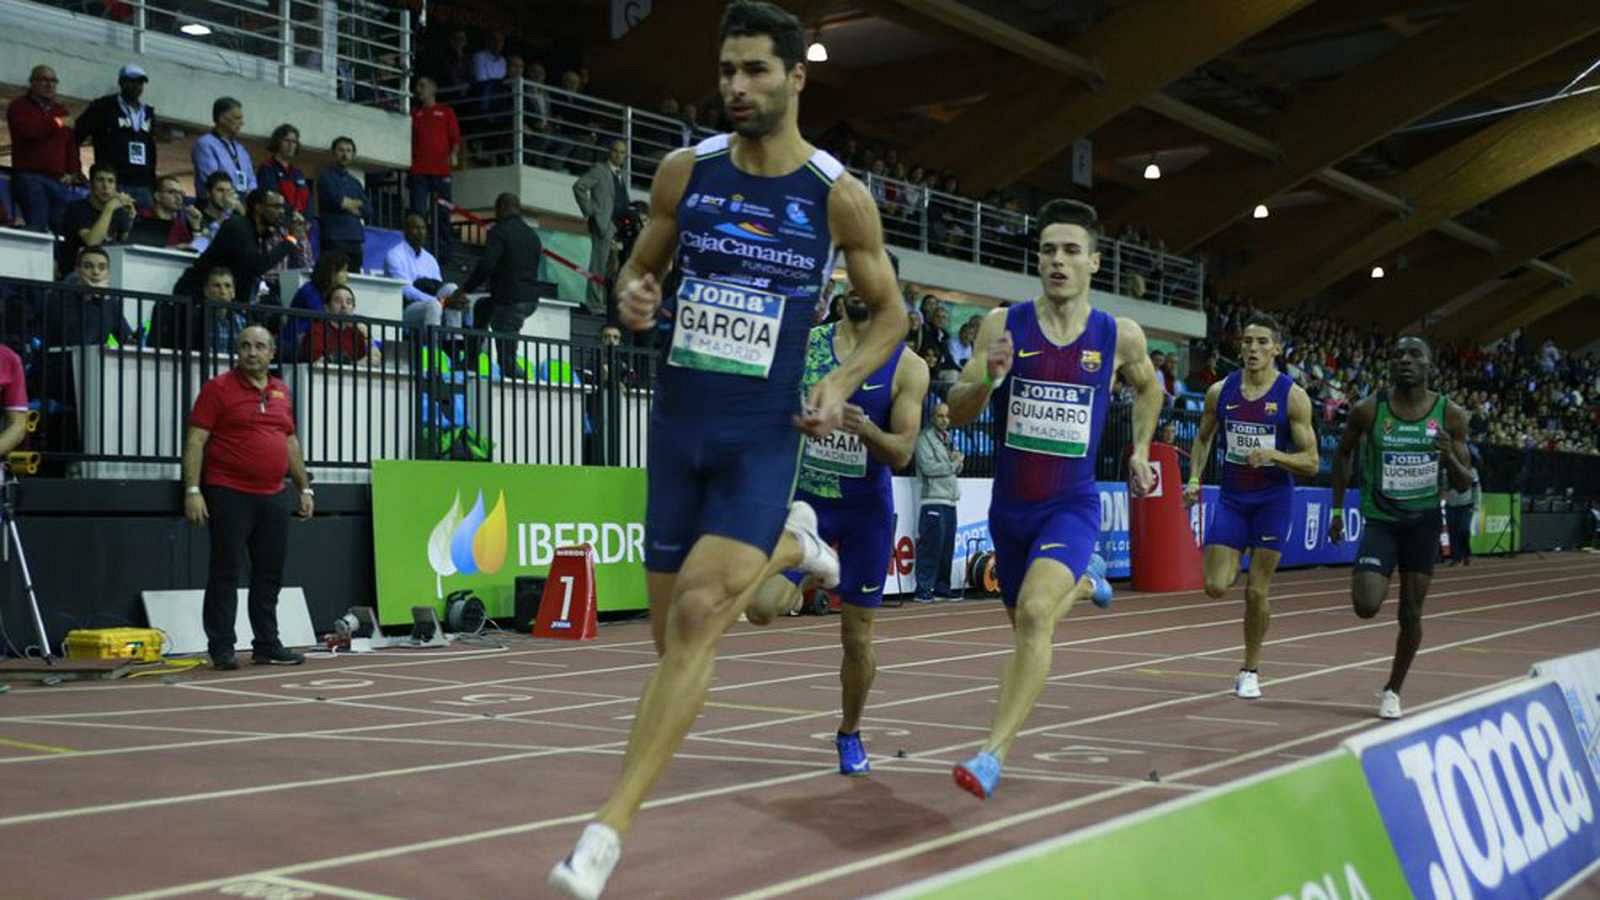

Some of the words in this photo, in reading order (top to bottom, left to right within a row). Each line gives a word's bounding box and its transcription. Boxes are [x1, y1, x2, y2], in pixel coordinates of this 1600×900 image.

[679, 230, 815, 270] CajaCanarias
[681, 305, 771, 348] GARCIA
[1010, 401, 1088, 424] GUIJARRO
[1237, 435, 1261, 448] BUA
[560, 576, 574, 621] 1
